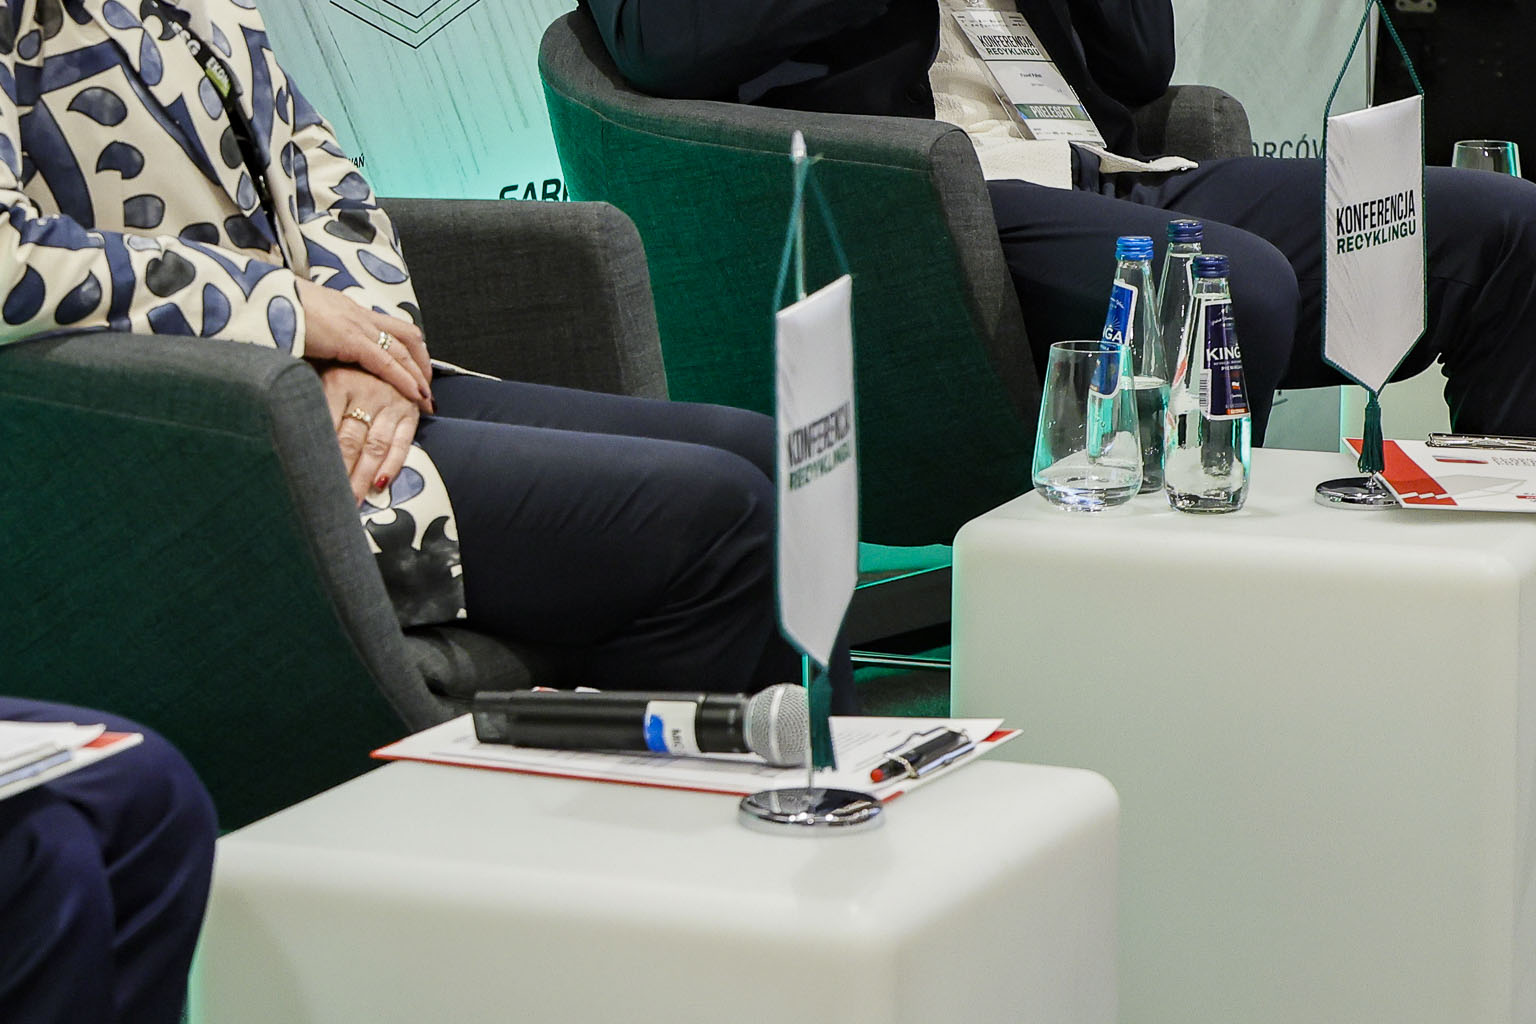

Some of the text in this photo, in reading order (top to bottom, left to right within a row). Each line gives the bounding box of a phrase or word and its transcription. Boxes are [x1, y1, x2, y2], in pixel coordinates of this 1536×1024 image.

[977, 35, 1035, 48] KONFERENCJA
[986, 47, 1040, 56] RECYKLINGU
[1029, 105, 1076, 119] PRELEGENT
[1336, 189, 1416, 237] KONFERENCJA
[1336, 219, 1416, 255] RECYKLINGU
